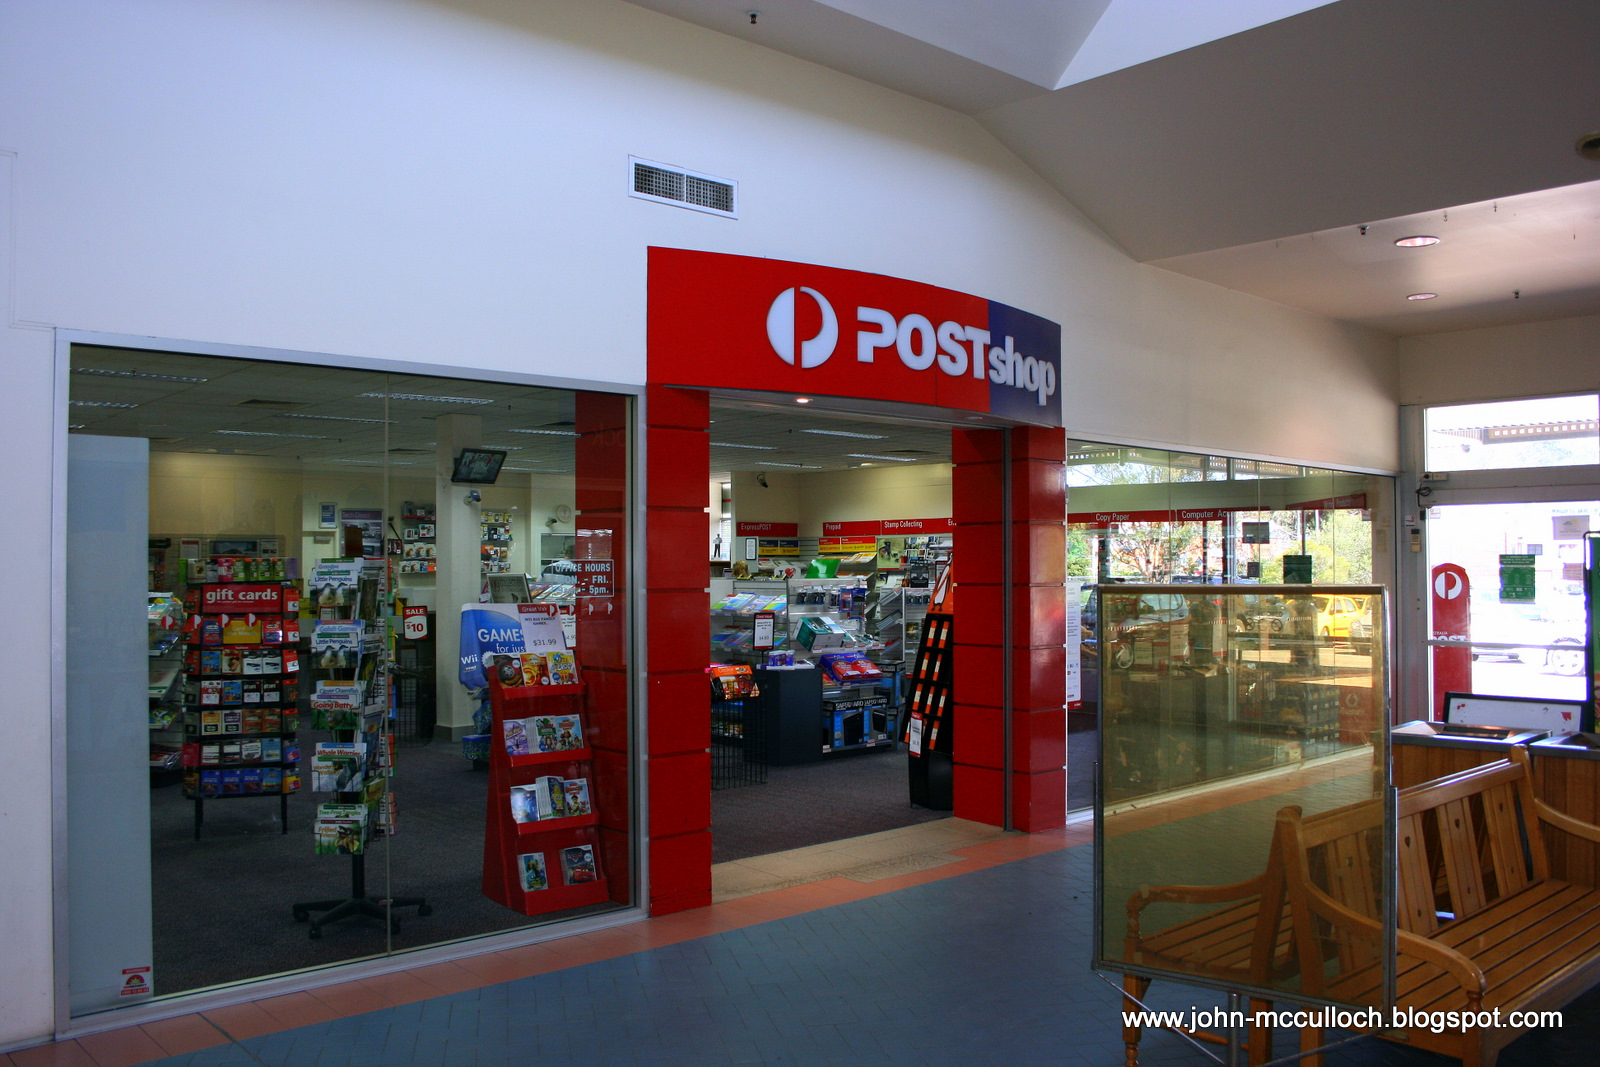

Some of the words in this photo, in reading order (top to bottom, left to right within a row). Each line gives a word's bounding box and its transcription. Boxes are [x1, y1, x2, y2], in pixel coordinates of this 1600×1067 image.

[1095, 513, 1111, 521] Copy
[1112, 513, 1130, 521] Paper
[1181, 511, 1214, 519] Computer
[741, 523, 771, 531] ExpressPOST
[825, 523, 841, 531] Prepaid
[884, 521, 899, 529] Stamp
[900, 520, 922, 528] Collecting
[555, 563, 582, 572] OFFICE
[585, 563, 611, 572] HOURS
[592, 575, 609, 584] FRI.
[589, 585, 609, 595] 5pm.
[206, 588, 234, 604] gift
[238, 588, 278, 600] cards
[406, 622, 424, 632] $10
[533, 638, 557, 647] $31.99
[496, 643, 509, 653] for
[511, 644, 525, 653] jus
[461, 654, 478, 665] Wii
[313, 701, 334, 710] Going
[334, 701, 353, 710] Batty
